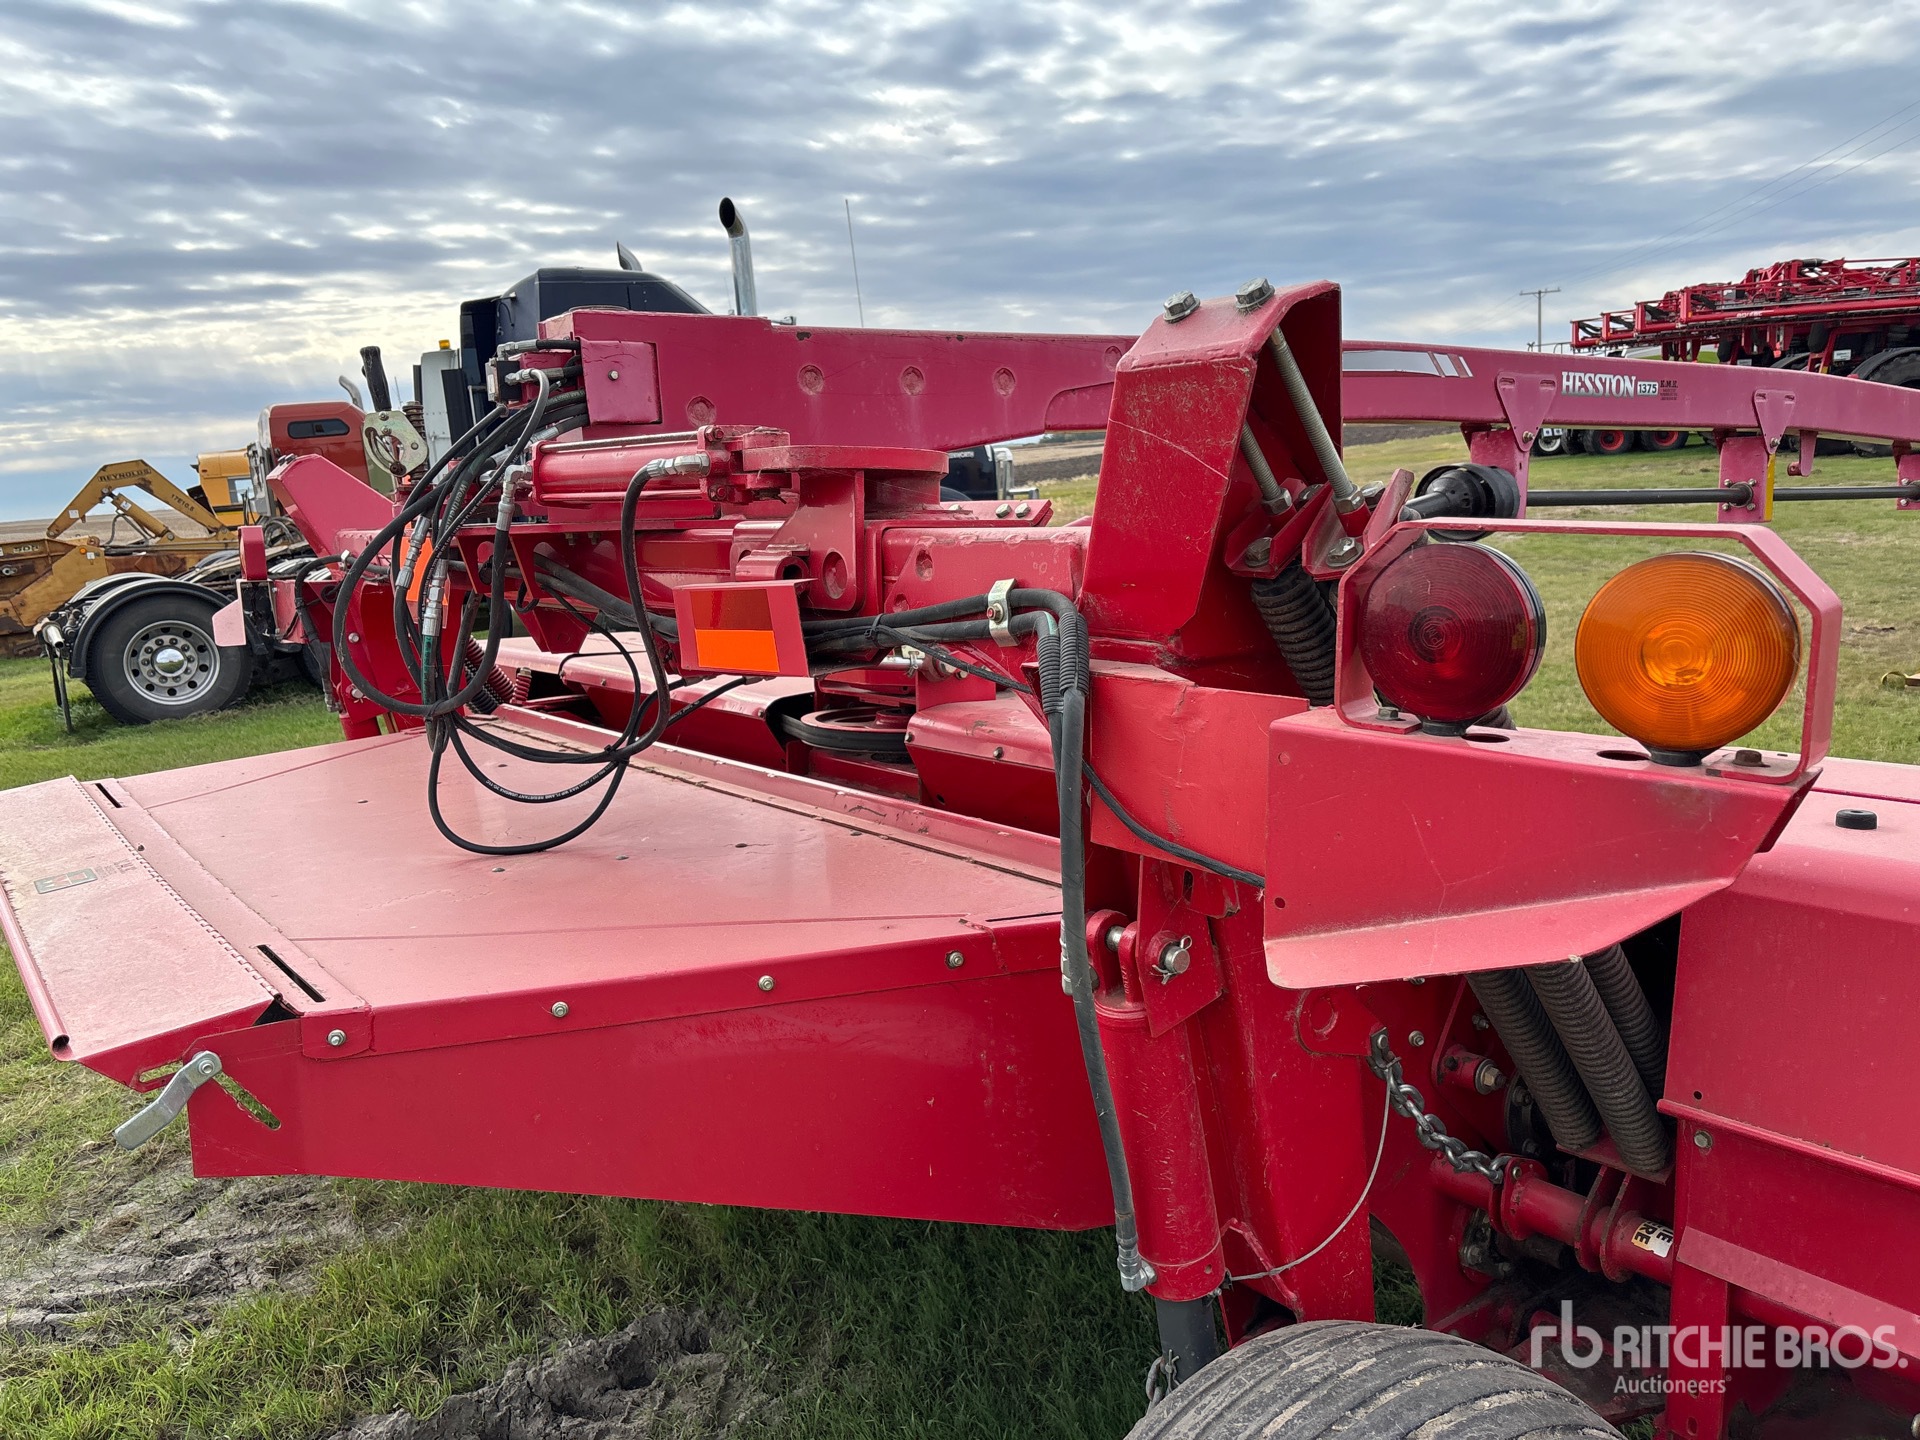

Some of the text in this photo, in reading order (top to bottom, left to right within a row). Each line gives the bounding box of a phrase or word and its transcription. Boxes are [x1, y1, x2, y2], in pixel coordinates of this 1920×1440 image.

[1561, 371, 1658, 398] HESSTON 1375
[99, 469, 151, 481] REYNOLDS
